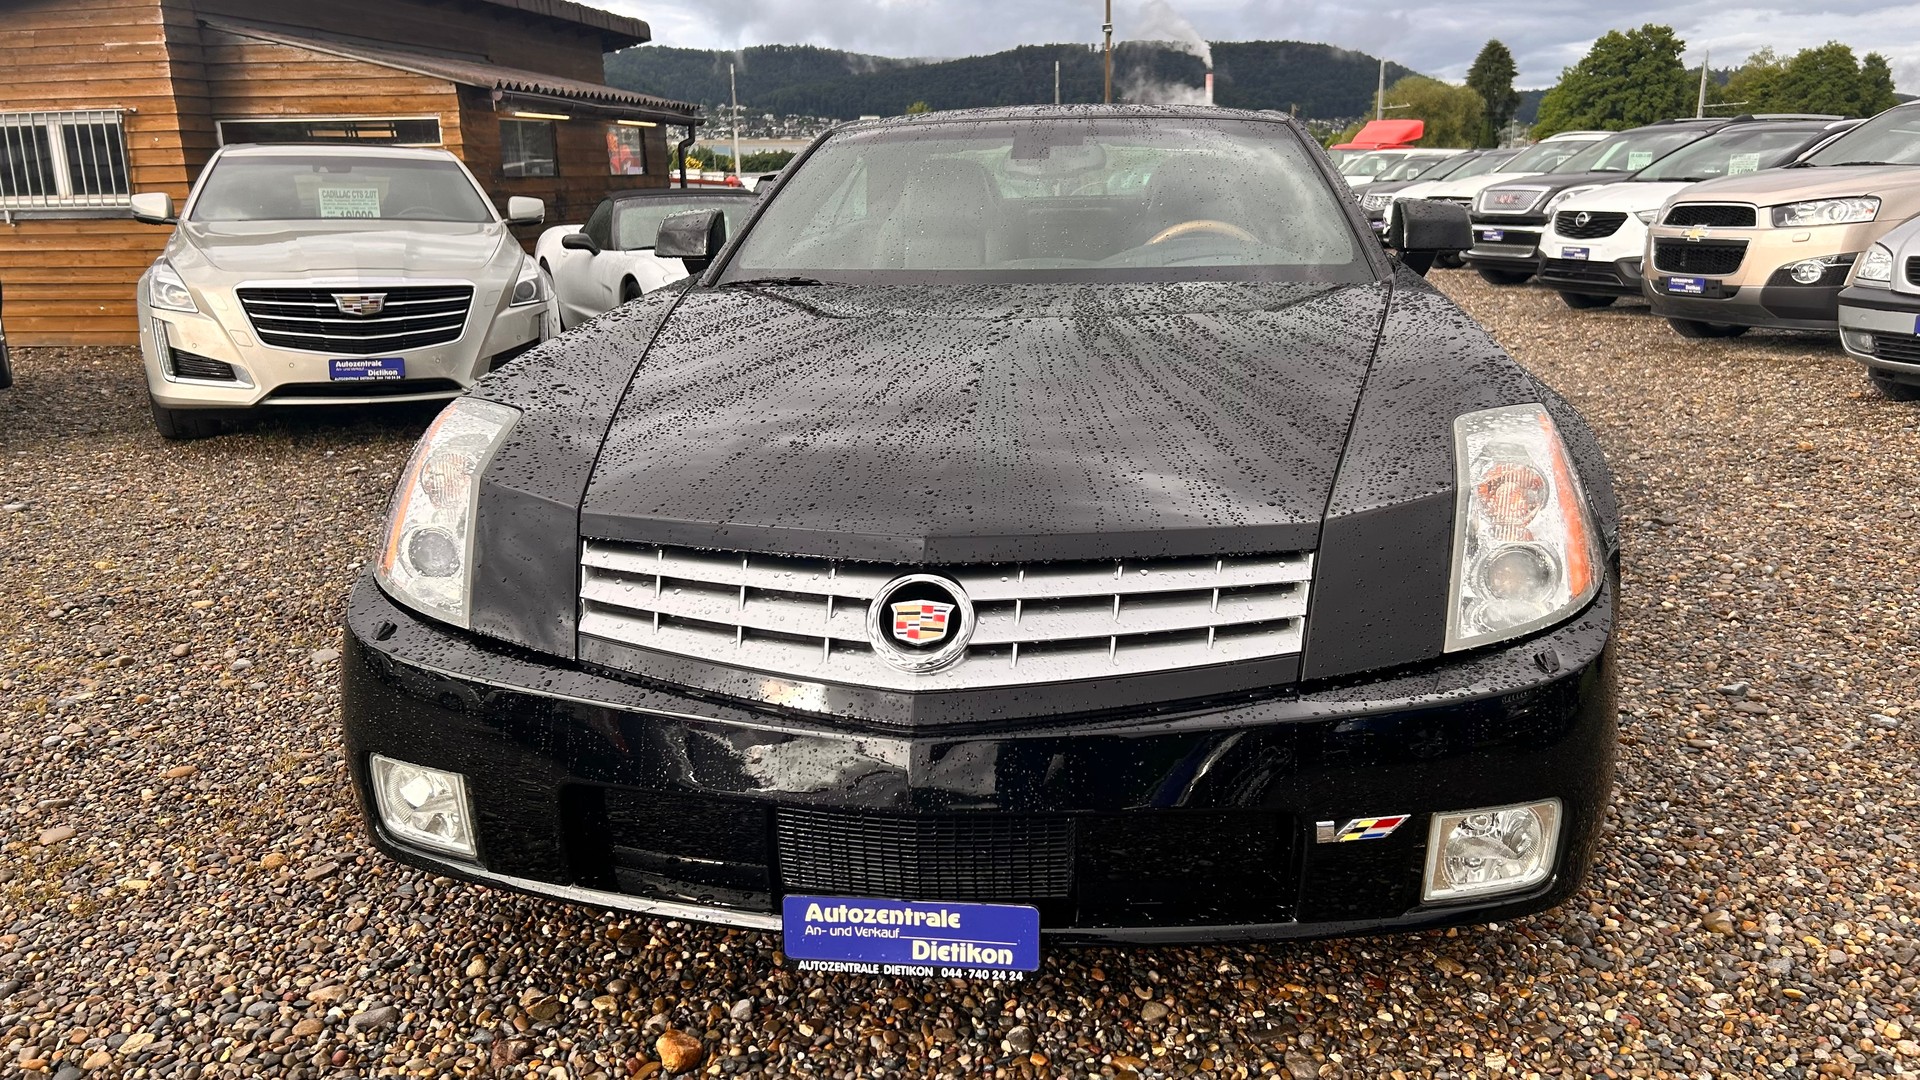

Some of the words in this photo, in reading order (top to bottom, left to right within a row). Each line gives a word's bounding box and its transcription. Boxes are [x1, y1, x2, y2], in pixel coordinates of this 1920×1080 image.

[322, 190, 351, 199] CADILLAC
[352, 190, 364, 199] CTS
[804, 903, 961, 929] Autozentrale
[804, 924, 828, 936] An-
[829, 926, 852, 937] und
[854, 926, 900, 939] Verkauf
[911, 939, 1014, 965] Dietikon
[797, 960, 880, 975] AUTOZENTRALE
[883, 964, 934, 977] DIETIKON
[991, 970, 1007, 981] 24
[1008, 971, 1024, 982] 24
